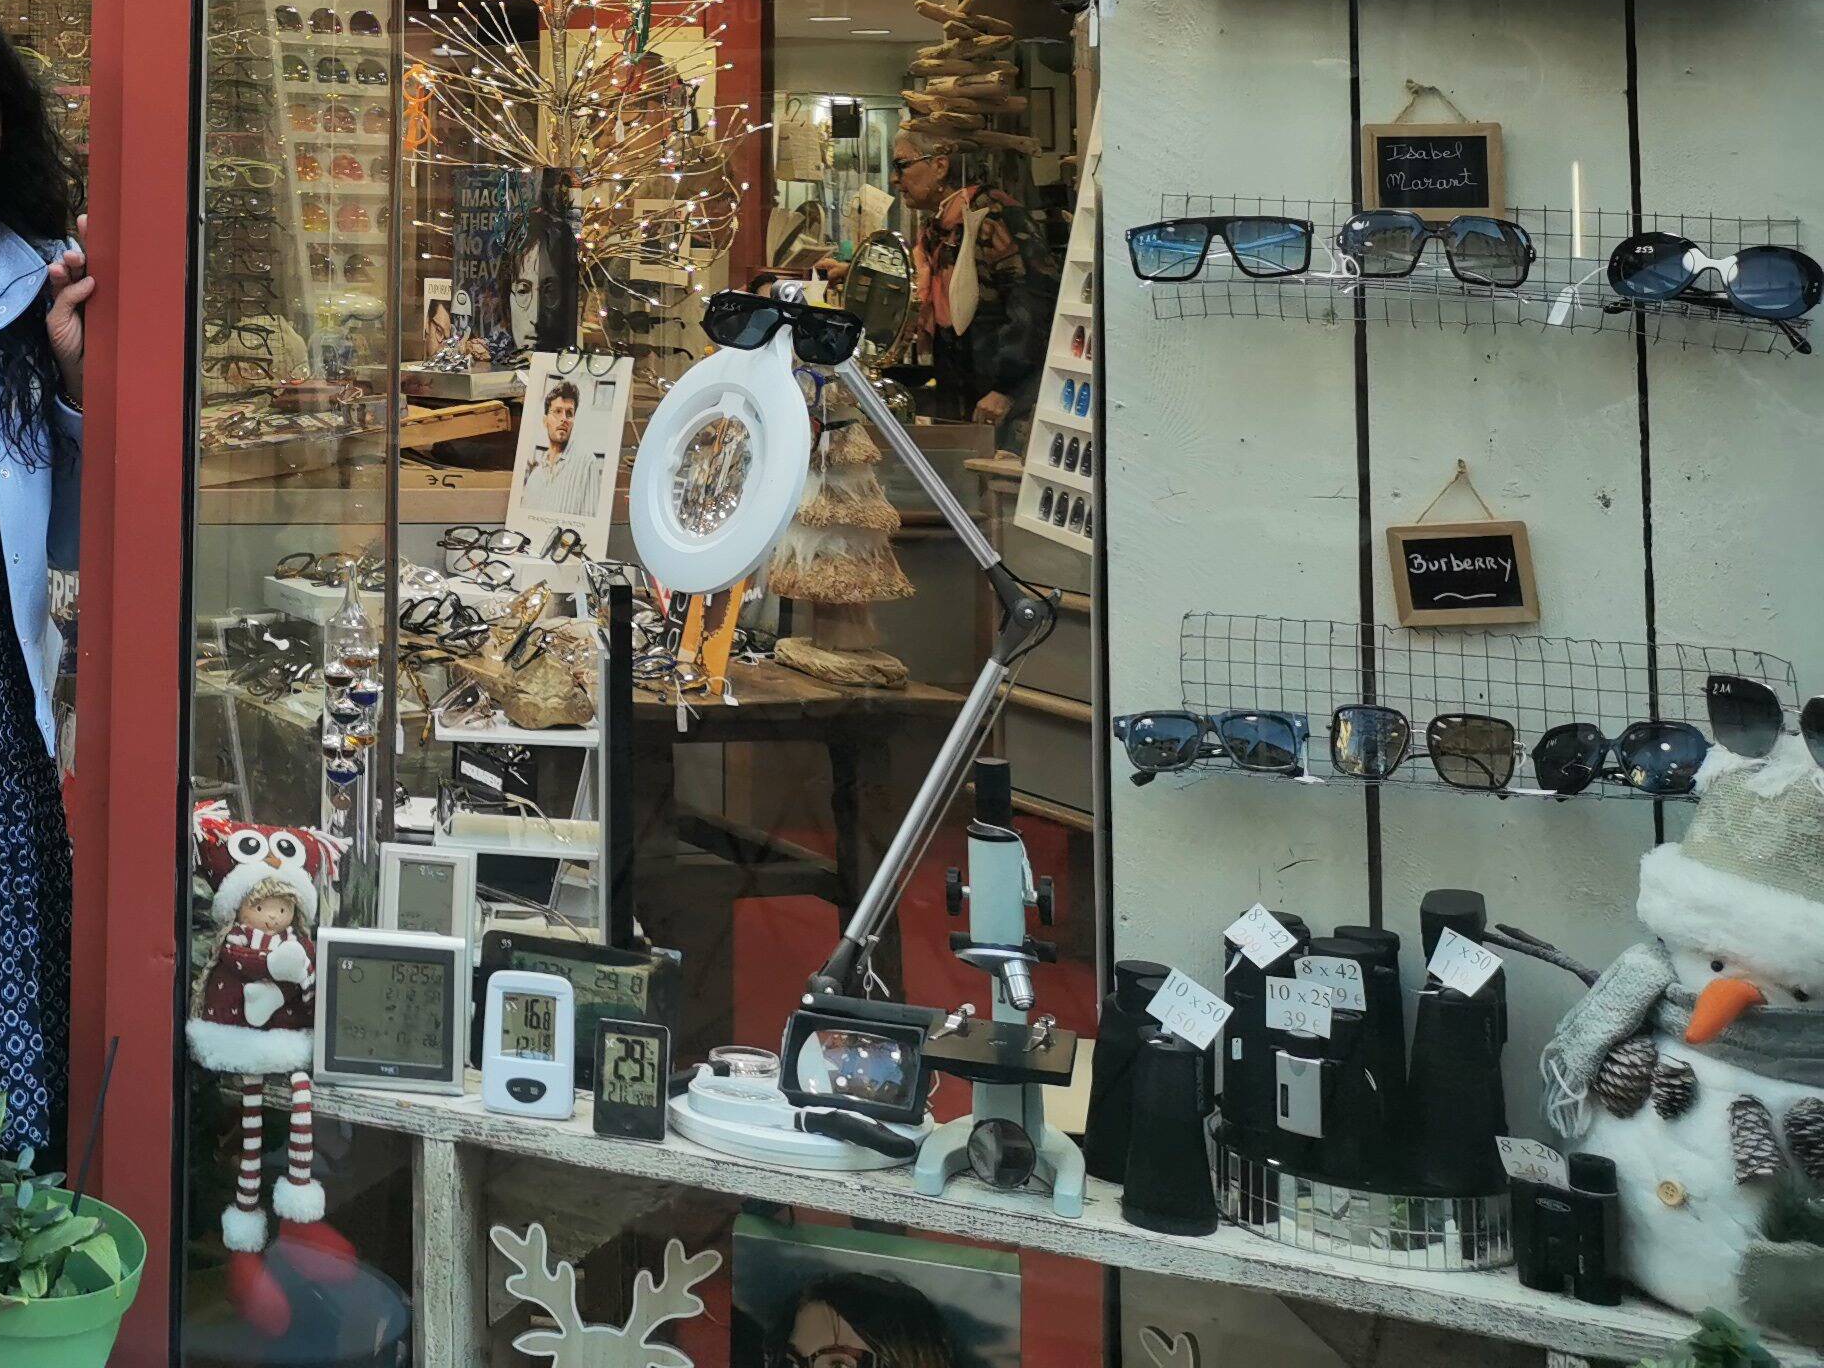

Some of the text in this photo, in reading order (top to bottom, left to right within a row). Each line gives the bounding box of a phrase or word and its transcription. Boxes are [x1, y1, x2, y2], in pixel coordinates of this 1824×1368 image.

[1386, 141, 1463, 160] Isabel
[1385, 168, 1478, 190] Marant
[1445, 932, 1457, 947] 7
[1470, 950, 1491, 971] 50
[1302, 959, 1358, 980] 8 x 42
[1166, 975, 1189, 996] 10
[1201, 1001, 1226, 1022] 50
[1269, 983, 1331, 1009] 10 x 25
[1283, 1010, 1306, 1029] 39
[1500, 1139, 1512, 1153] 8
[1535, 1143, 1559, 1162] 20
